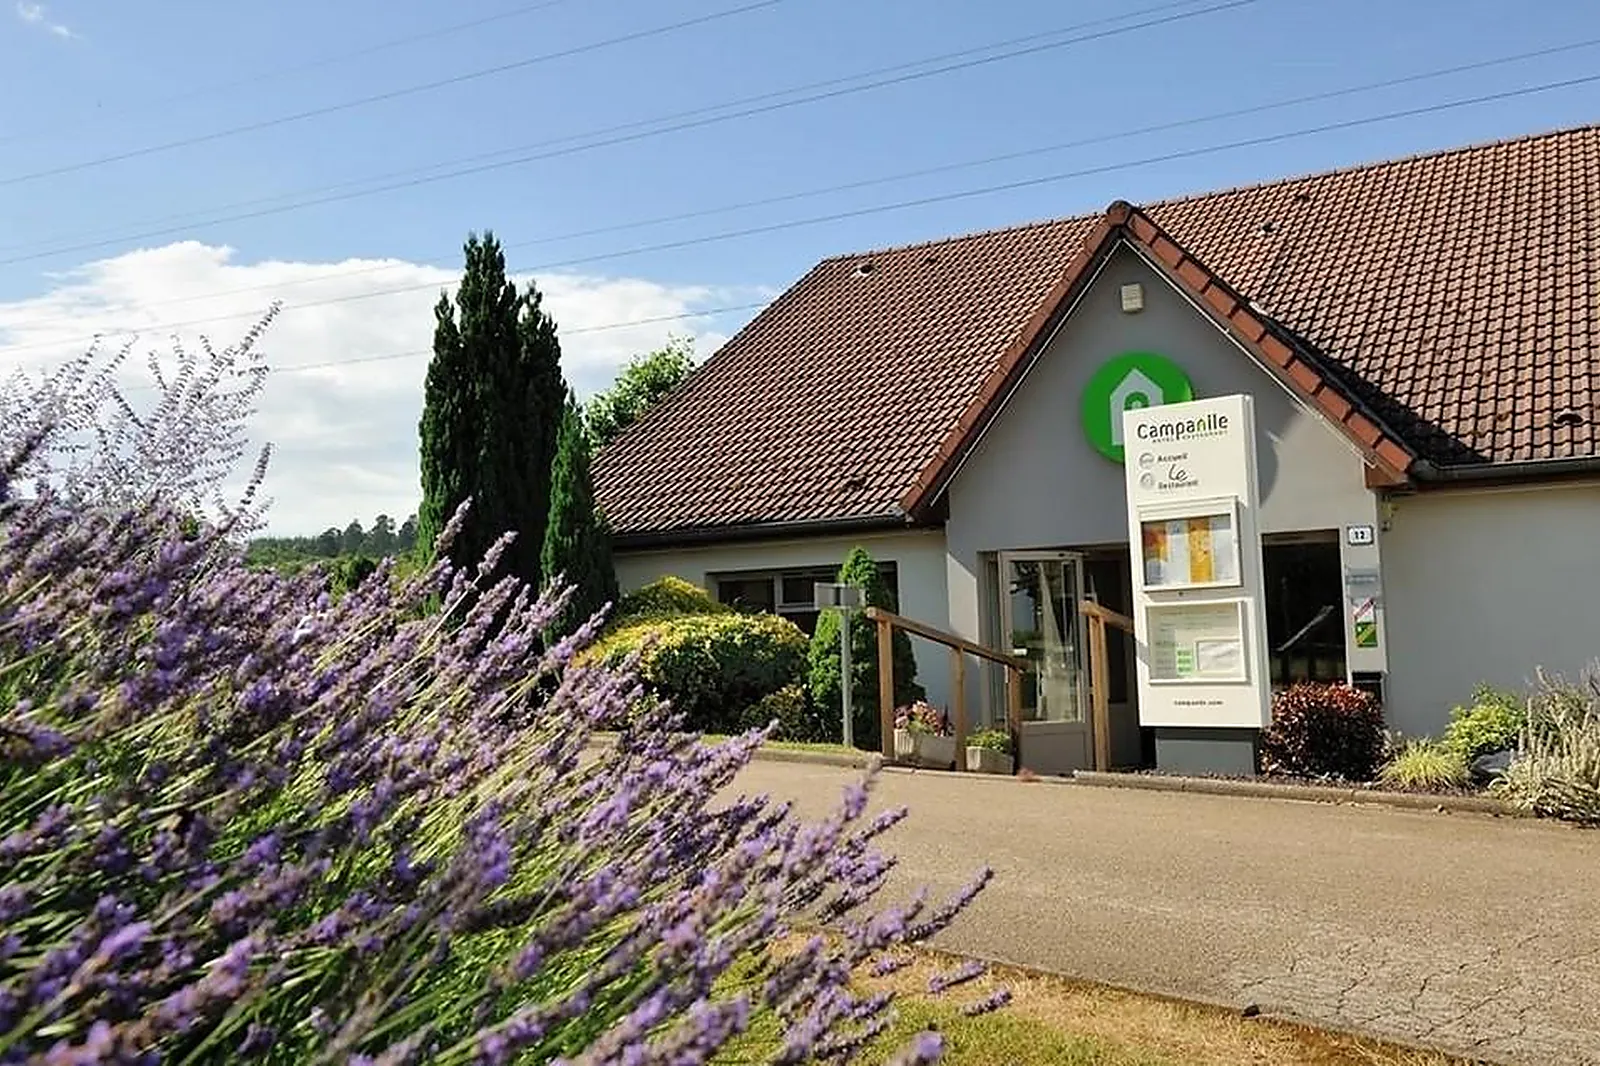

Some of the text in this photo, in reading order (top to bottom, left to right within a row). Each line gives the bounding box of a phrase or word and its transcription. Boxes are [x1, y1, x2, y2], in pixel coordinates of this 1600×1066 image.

[1137, 413, 1229, 440] Campanile
[1168, 463, 1188, 482] Le
[1354, 531, 1366, 540] 12
